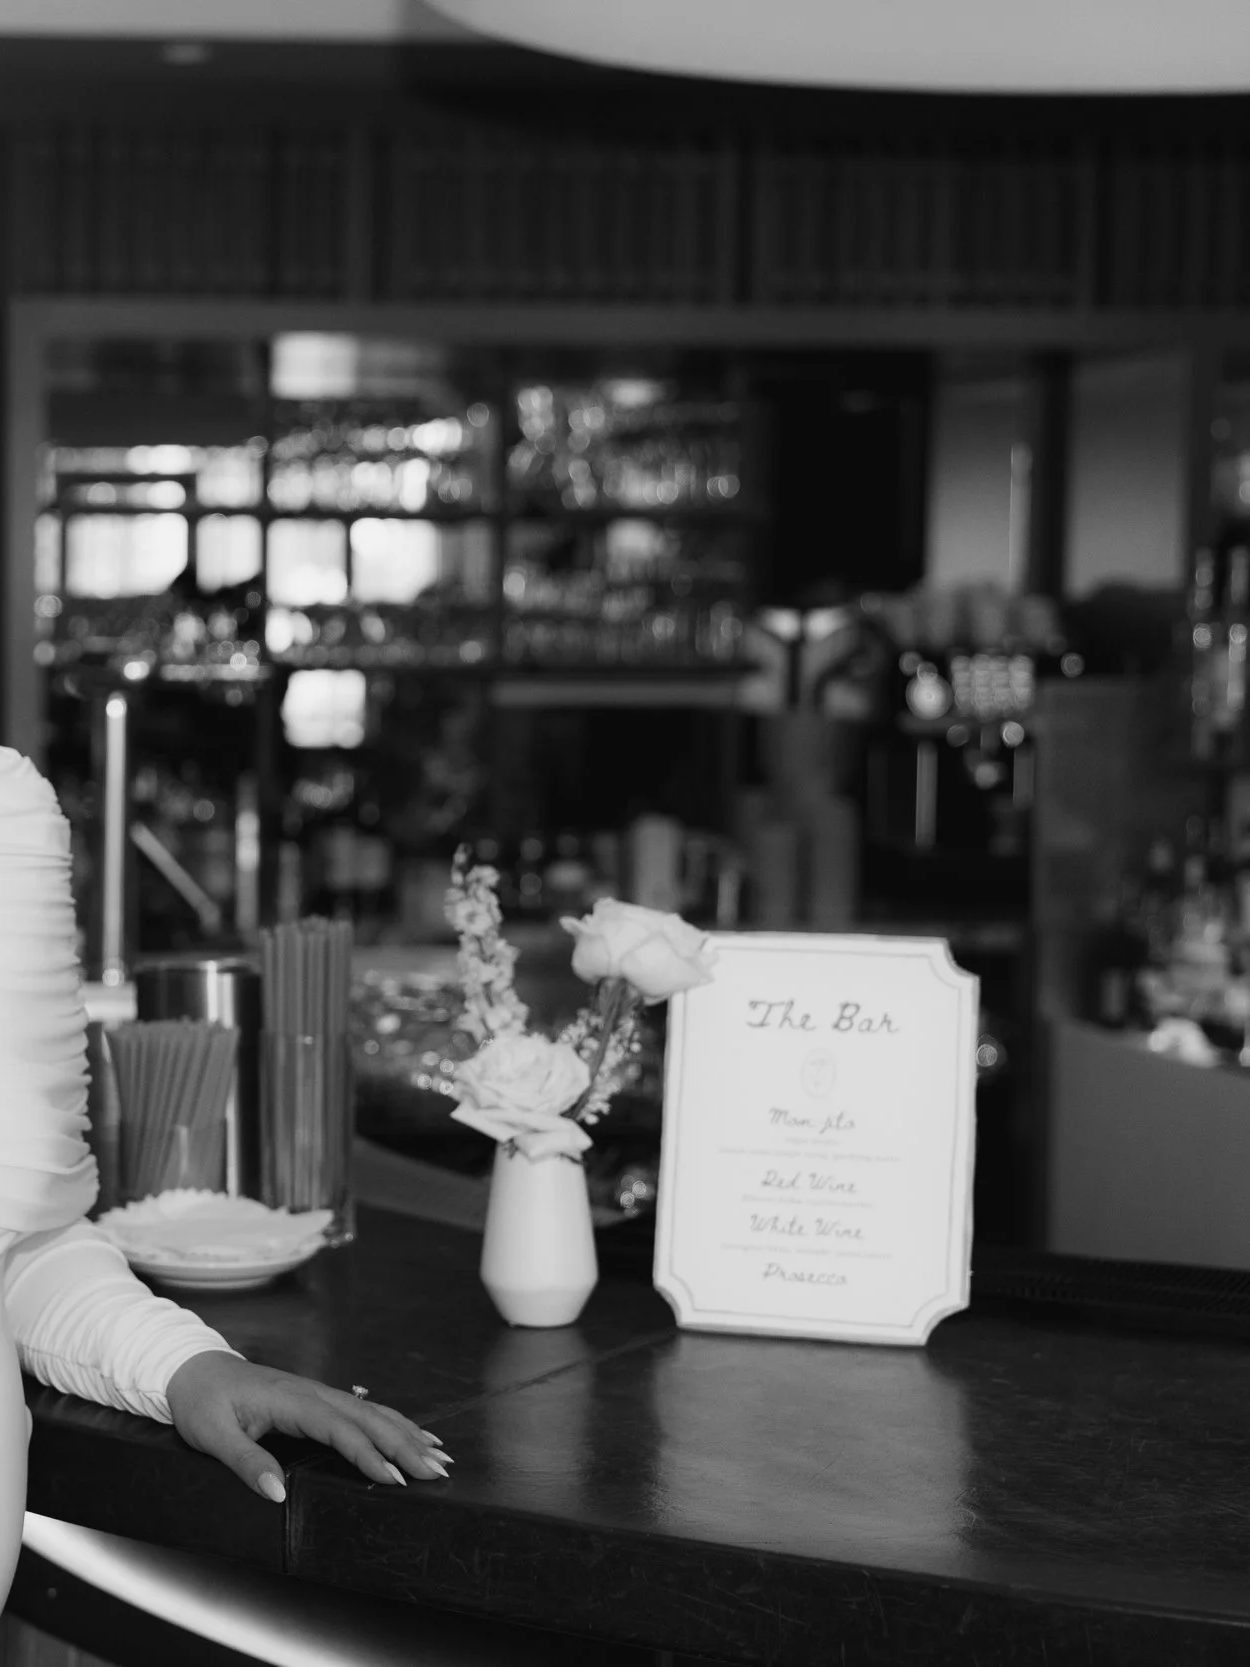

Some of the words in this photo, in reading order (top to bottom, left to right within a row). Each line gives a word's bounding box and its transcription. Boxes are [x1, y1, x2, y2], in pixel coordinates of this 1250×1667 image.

[745, 998, 817, 1032] The
[830, 1000, 900, 1034] Bar
[760, 1169, 801, 1190] Red
[808, 1172, 857, 1194] Wine
[750, 1213, 805, 1237] White
[814, 1217, 863, 1240] Wine
[761, 1262, 848, 1285] Prosecco
